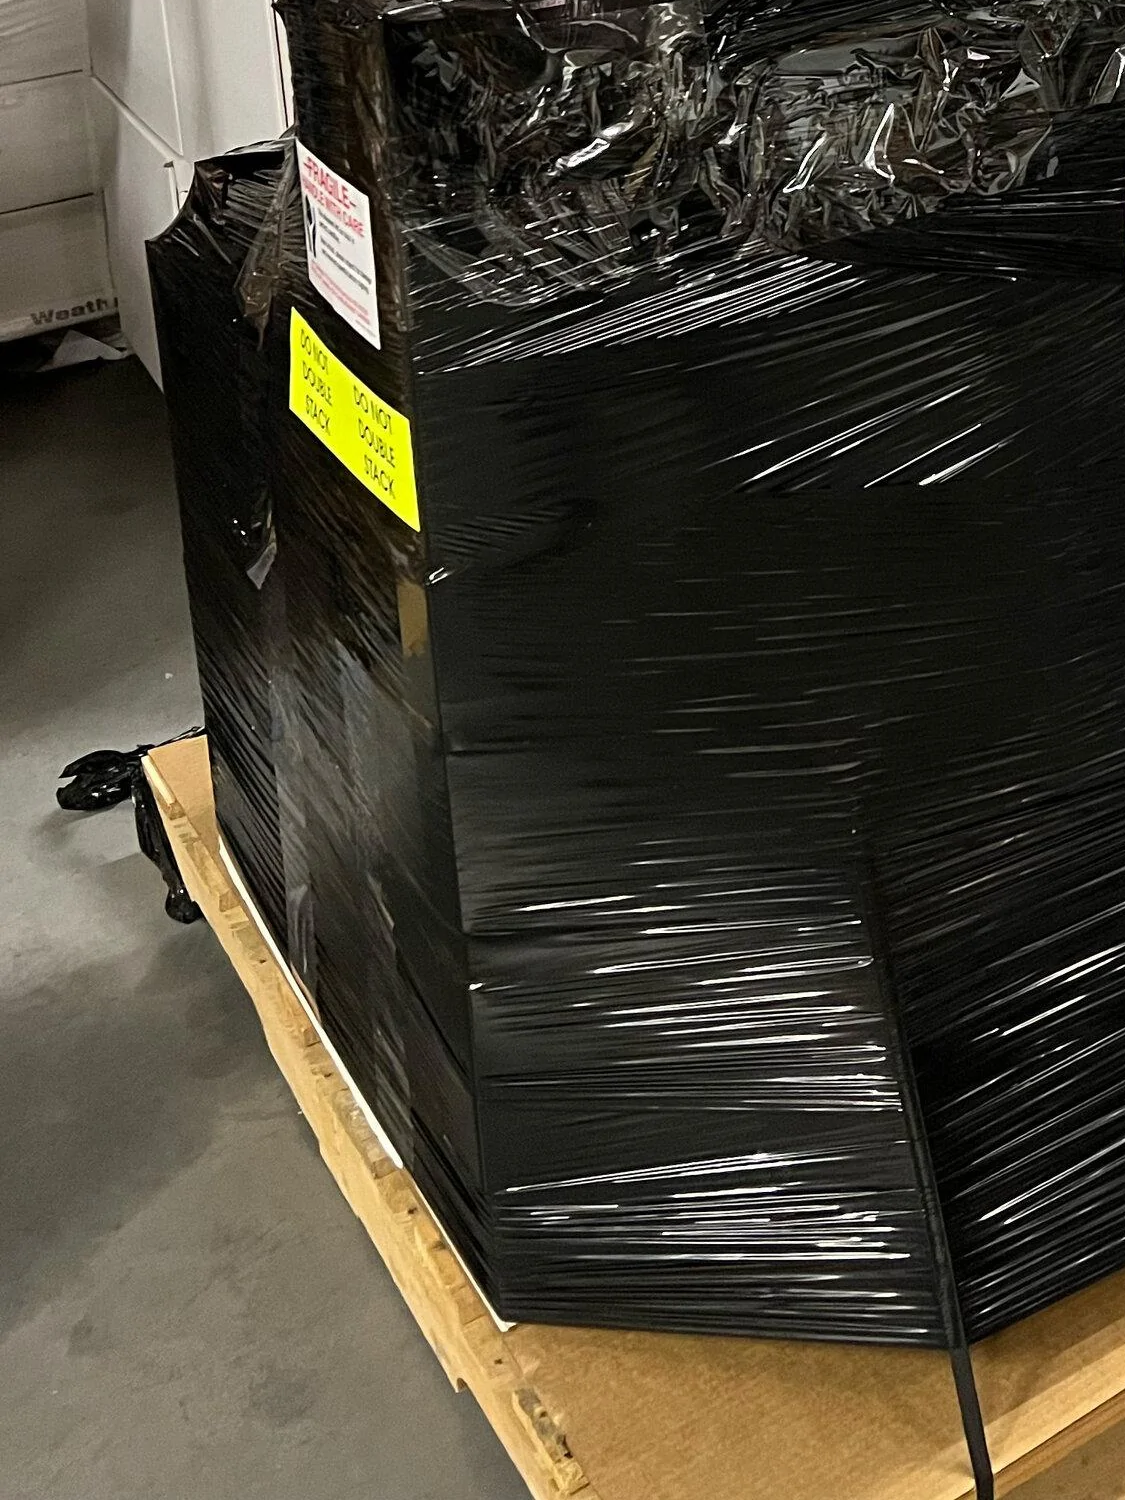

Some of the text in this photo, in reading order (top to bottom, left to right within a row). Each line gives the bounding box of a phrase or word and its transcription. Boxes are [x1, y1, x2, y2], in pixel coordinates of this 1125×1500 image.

[301, 329, 329, 375] DO NOT
[302, 360, 333, 407] DOUBLE
[305, 394, 331, 436] STACK
[353, 385, 393, 435] DO NOT
[357, 418, 396, 469] DOUBLE
[364, 454, 396, 500] STACK
